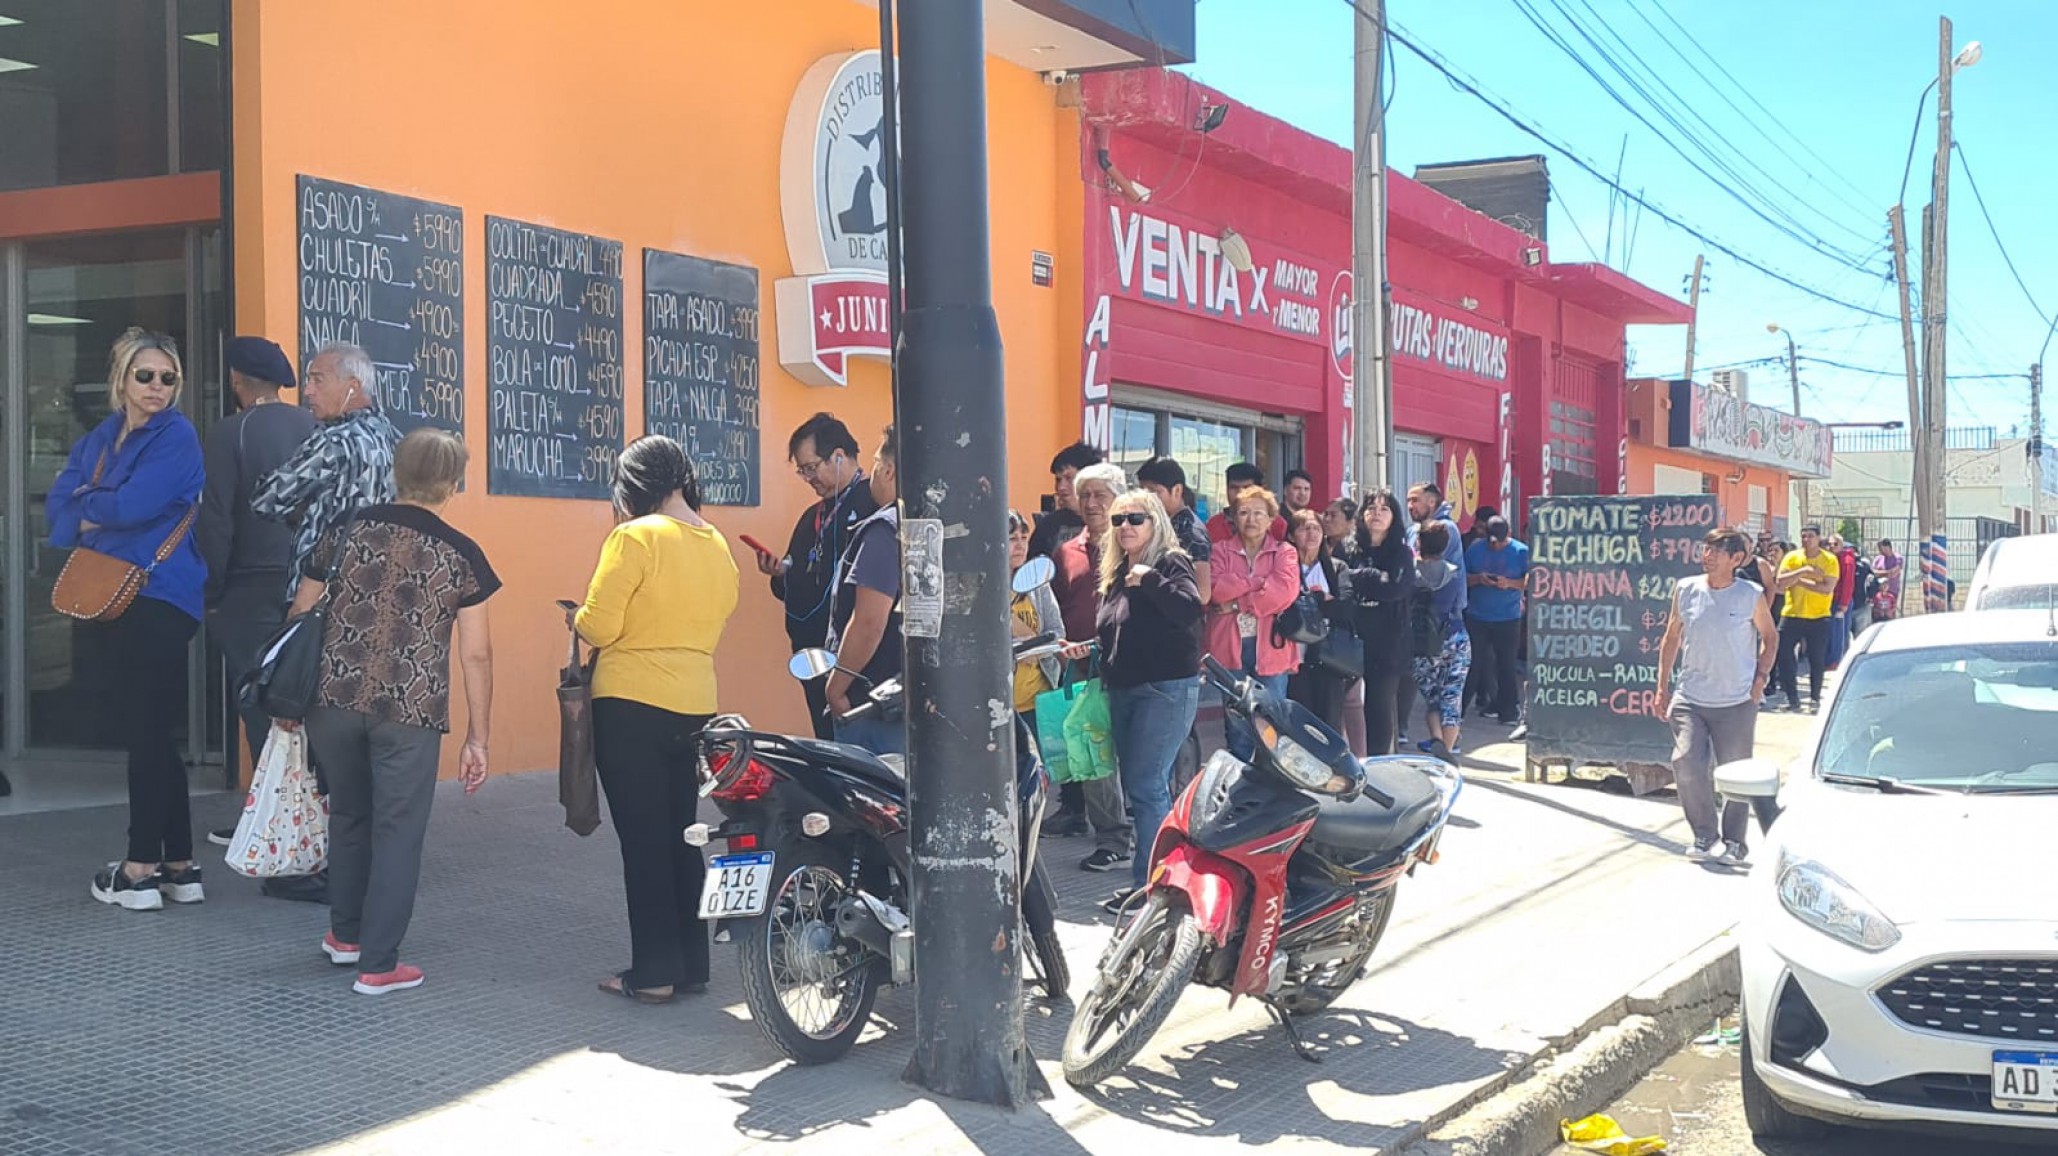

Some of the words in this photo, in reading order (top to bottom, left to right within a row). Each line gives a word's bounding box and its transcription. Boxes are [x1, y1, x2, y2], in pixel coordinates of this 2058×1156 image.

[303, 186, 363, 234] ASADO
[413, 211, 462, 254] $5990
[301, 233, 394, 284] CHULETAS
[848, 237, 866, 258] DE
[870, 238, 888, 261] CA
[1110, 205, 1243, 321] VENTA
[302, 275, 375, 322] CUADRIL
[492, 263, 565, 309] CUADRADA
[1273, 258, 1319, 298] MAYOR
[493, 303, 554, 345] PECETO
[648, 293, 679, 331] TAPA
[686, 295, 726, 336] ASADO
[836, 296, 887, 332] JUNI
[1278, 298, 1321, 336] MENOR
[647, 335, 692, 378] PICADA
[694, 342, 719, 383] ESP
[1389, 300, 1433, 360] UTAS
[1436, 316, 1509, 382] VERDURAS
[493, 345, 533, 387] BOLA
[543, 350, 578, 394] LOMO
[1085, 294, 1111, 455] ALM
[494, 390, 550, 434] PALETA
[646, 380, 682, 419] TAPA
[690, 384, 728, 429] NALGA
[493, 434, 564, 479] MARUCHA
[1533, 504, 1642, 532] TOMATE
[1532, 534, 1643, 564] LECHUGA
[1532, 567, 1634, 600] BANANA
[1637, 573, 1678, 601] $22
[1537, 604, 1632, 632] PEREGIL
[1641, 610, 1668, 630] $2
[1534, 634, 1620, 660] VERDEO
[1638, 635, 1661, 655] $2
[1535, 663, 1596, 683] RUCULA
[1534, 688, 1598, 707] ACELGA
[1609, 688, 1657, 717] CER
[718, 867, 756, 889] A16
[1250, 895, 1279, 970] KYMCO
[2002, 1066, 2041, 1096] AD
